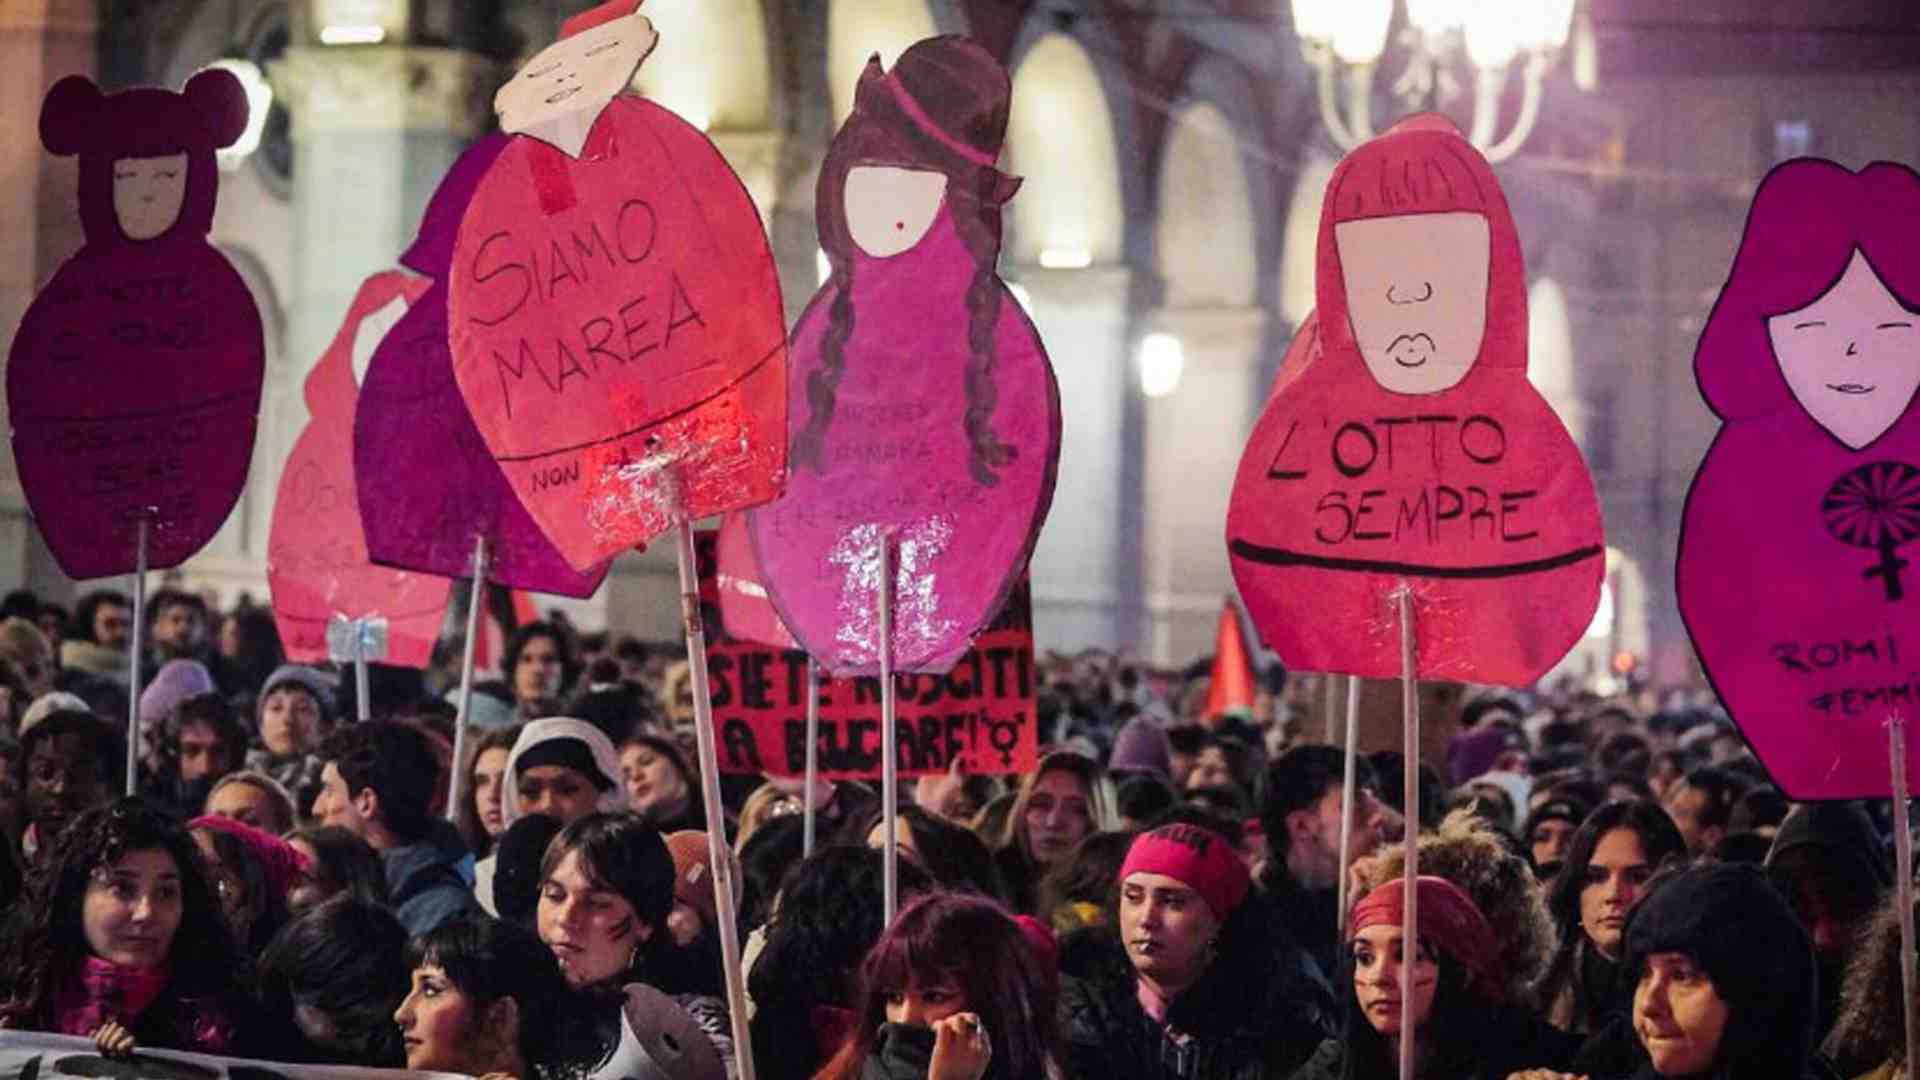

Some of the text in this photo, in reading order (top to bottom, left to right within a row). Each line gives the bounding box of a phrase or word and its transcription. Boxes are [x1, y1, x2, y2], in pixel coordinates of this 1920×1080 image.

[469, 198, 657, 328] SIAMO
[491, 273, 706, 421] MAREA
[531, 459, 580, 494] NON
[1266, 414, 1507, 480] L'OTTO
[1313, 486, 1540, 546] SEMPRE
[721, 717, 763, 778] A
